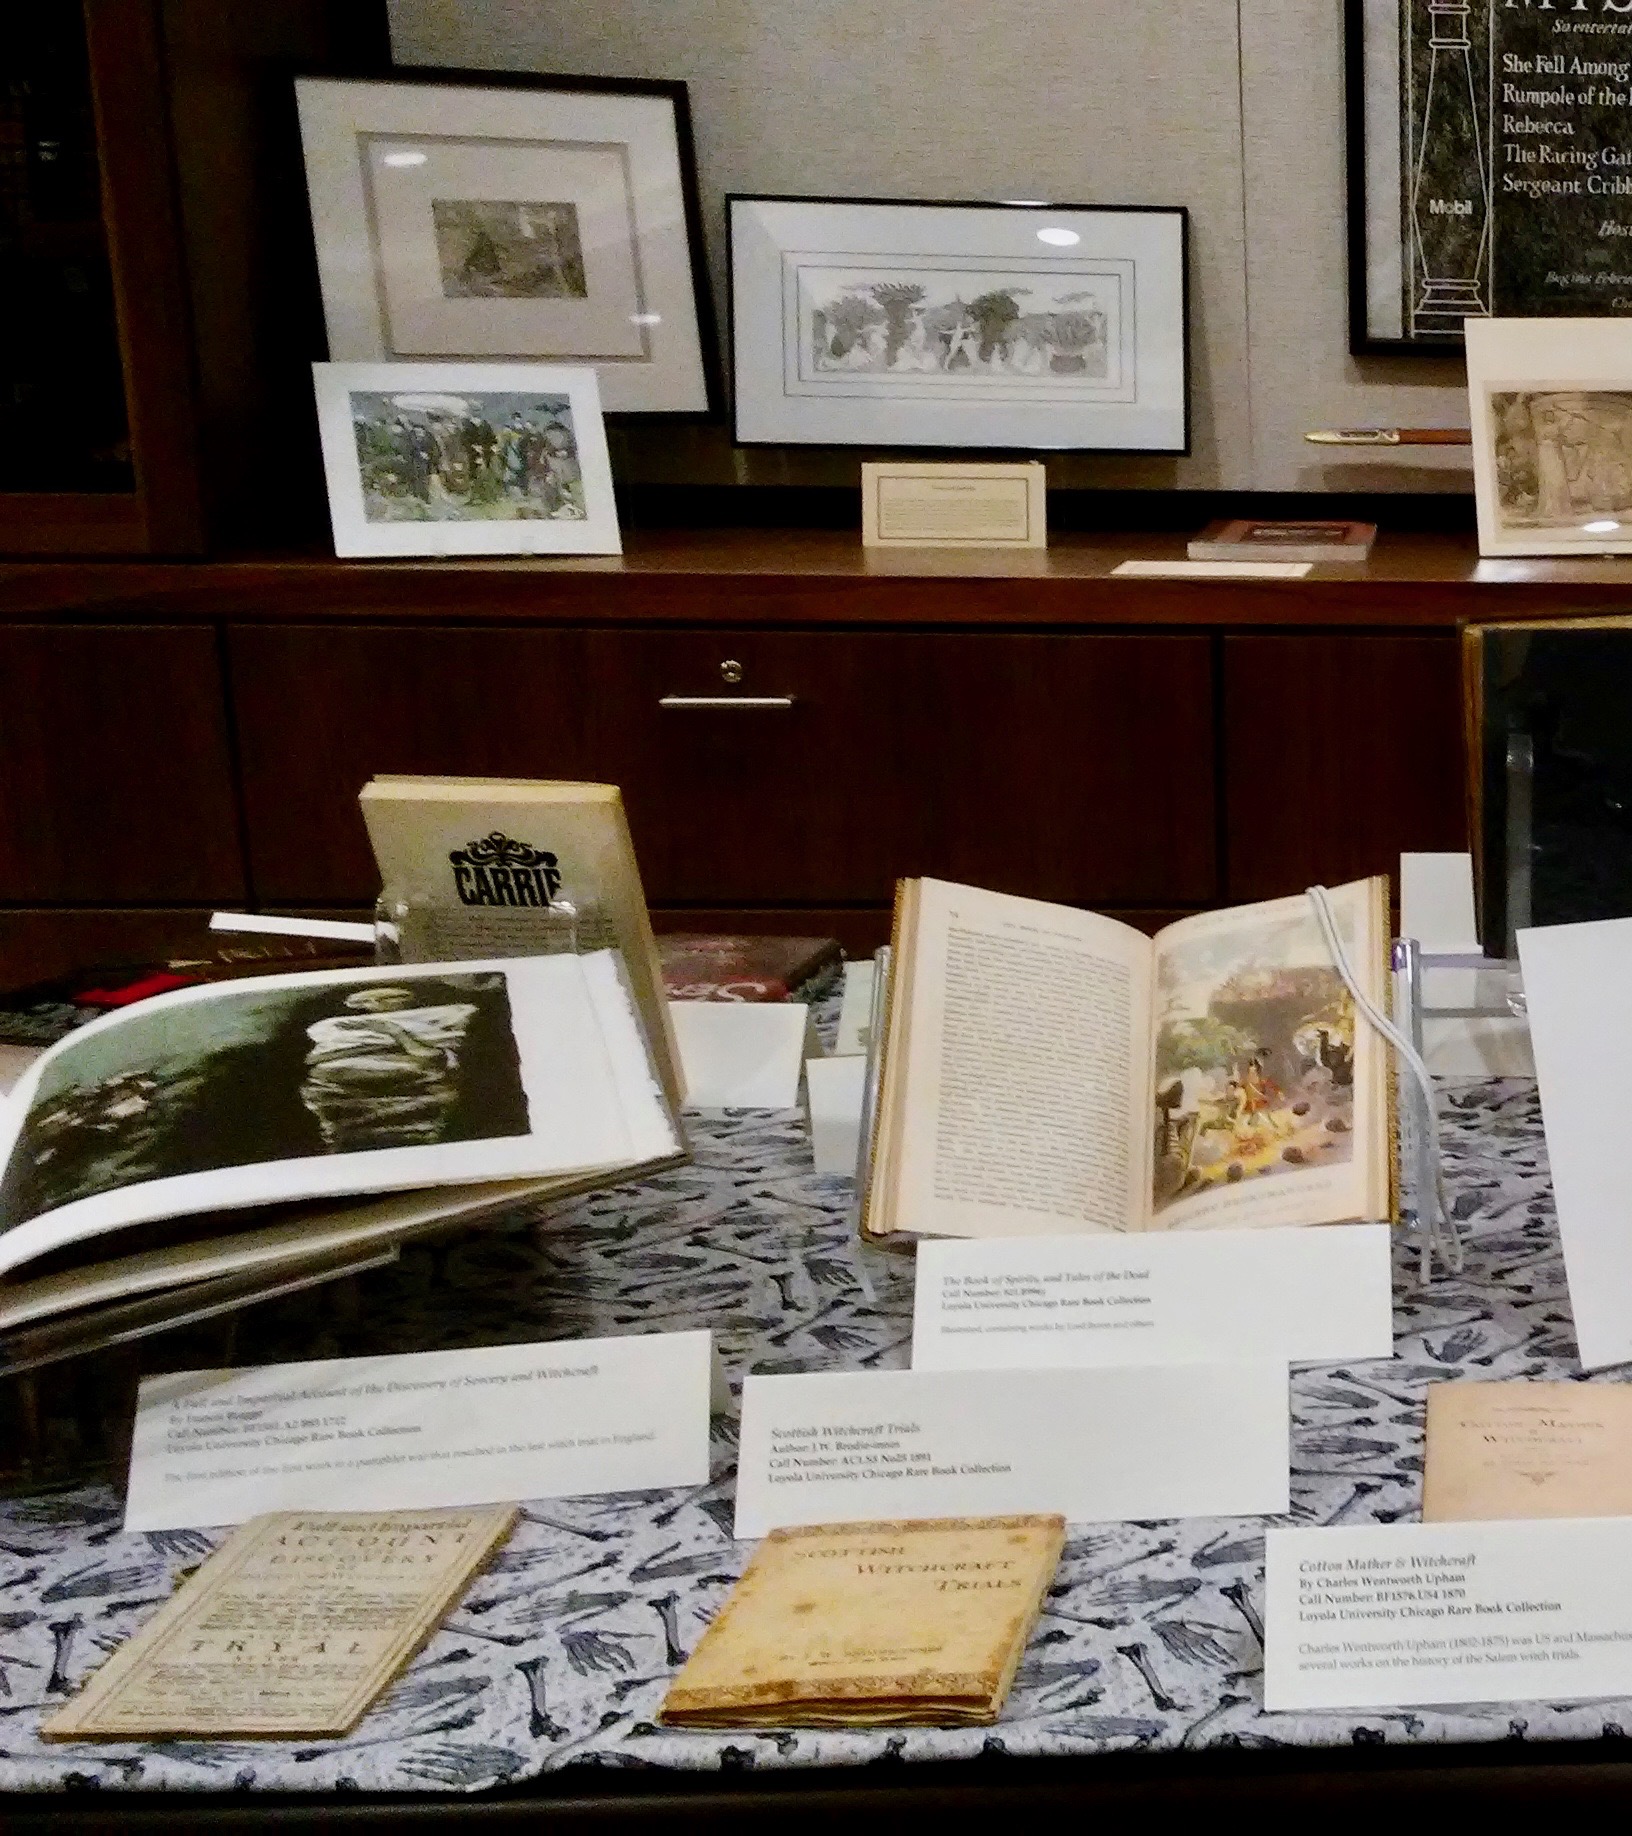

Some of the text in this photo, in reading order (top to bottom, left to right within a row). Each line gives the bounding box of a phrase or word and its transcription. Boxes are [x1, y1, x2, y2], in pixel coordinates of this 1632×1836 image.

[1502, 54, 1532, 74] She
[1535, 55, 1565, 75] Fell
[1569, 56, 1630, 82] Among
[1502, 83, 1575, 108] Rumpole
[1578, 86, 1597, 105] of
[1598, 86, 1626, 105] the
[1502, 114, 1575, 135] Rebecca
[1502, 143, 1537, 164] The
[1539, 145, 1600, 170] Racing
[1502, 173, 1582, 199] Sergeant
[1429, 199, 1473, 215] Mobil
[770, 1427, 819, 1440] Scottish
[861, 1467, 904, 1482] Chicago
[931, 1465, 958, 1476] Book
[959, 1462, 1013, 1475] Collection
[1299, 1560, 1343, 1574] Cotton
[1348, 1558, 1392, 1572] Mather
[1410, 1553, 1476, 1571] Witchcraft
[1299, 1573, 1467, 1591] By Charles Wentworth Upham
[1299, 1594, 1323, 1606] Call
[1299, 1600, 1563, 1623] Loyola University Chicago Rare Book Collection
[1299, 1642, 1340, 1655] Charles
[1342, 1639, 1404, 1654] Wentworth
[1405, 1637, 1447, 1653] Upham
[1510, 1636, 1533, 1647] was
[1552, 1632, 1575, 1644] and
[1299, 1658, 1338, 1672] several
[1339, 1657, 1374, 1670] works
[1391, 1655, 1411, 1668] the
[1411, 1653, 1450, 1670] history
[1451, 1653, 1466, 1666] of
[1466, 1651, 1483, 1665] the
